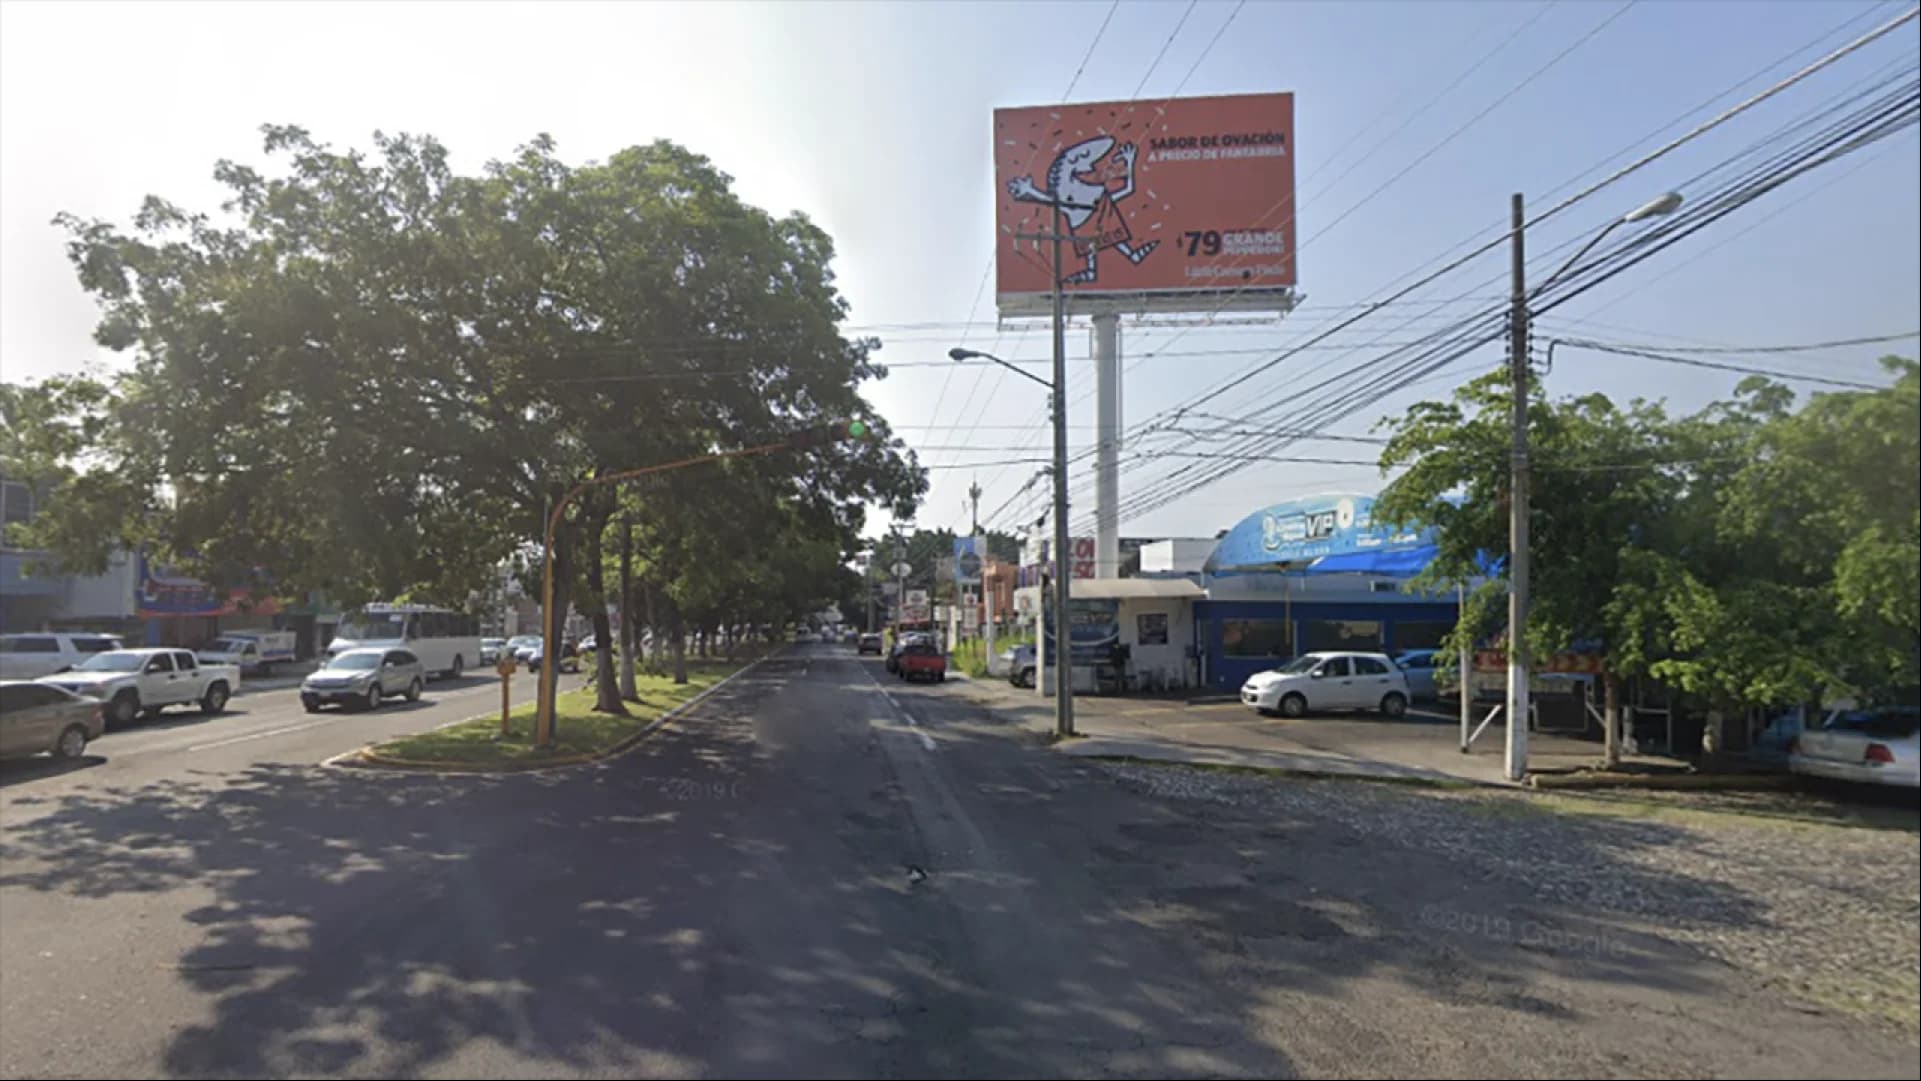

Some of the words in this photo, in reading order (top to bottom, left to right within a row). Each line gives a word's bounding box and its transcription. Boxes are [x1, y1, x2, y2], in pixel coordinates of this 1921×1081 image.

[1150, 136, 1197, 149] SABOR
[1201, 135, 1219, 148] DE
[1222, 132, 1285, 146] OVACIÓN
[1148, 151, 1158, 162] A
[1203, 148, 1217, 160] DE
[1305, 514, 1334, 538] VIP
